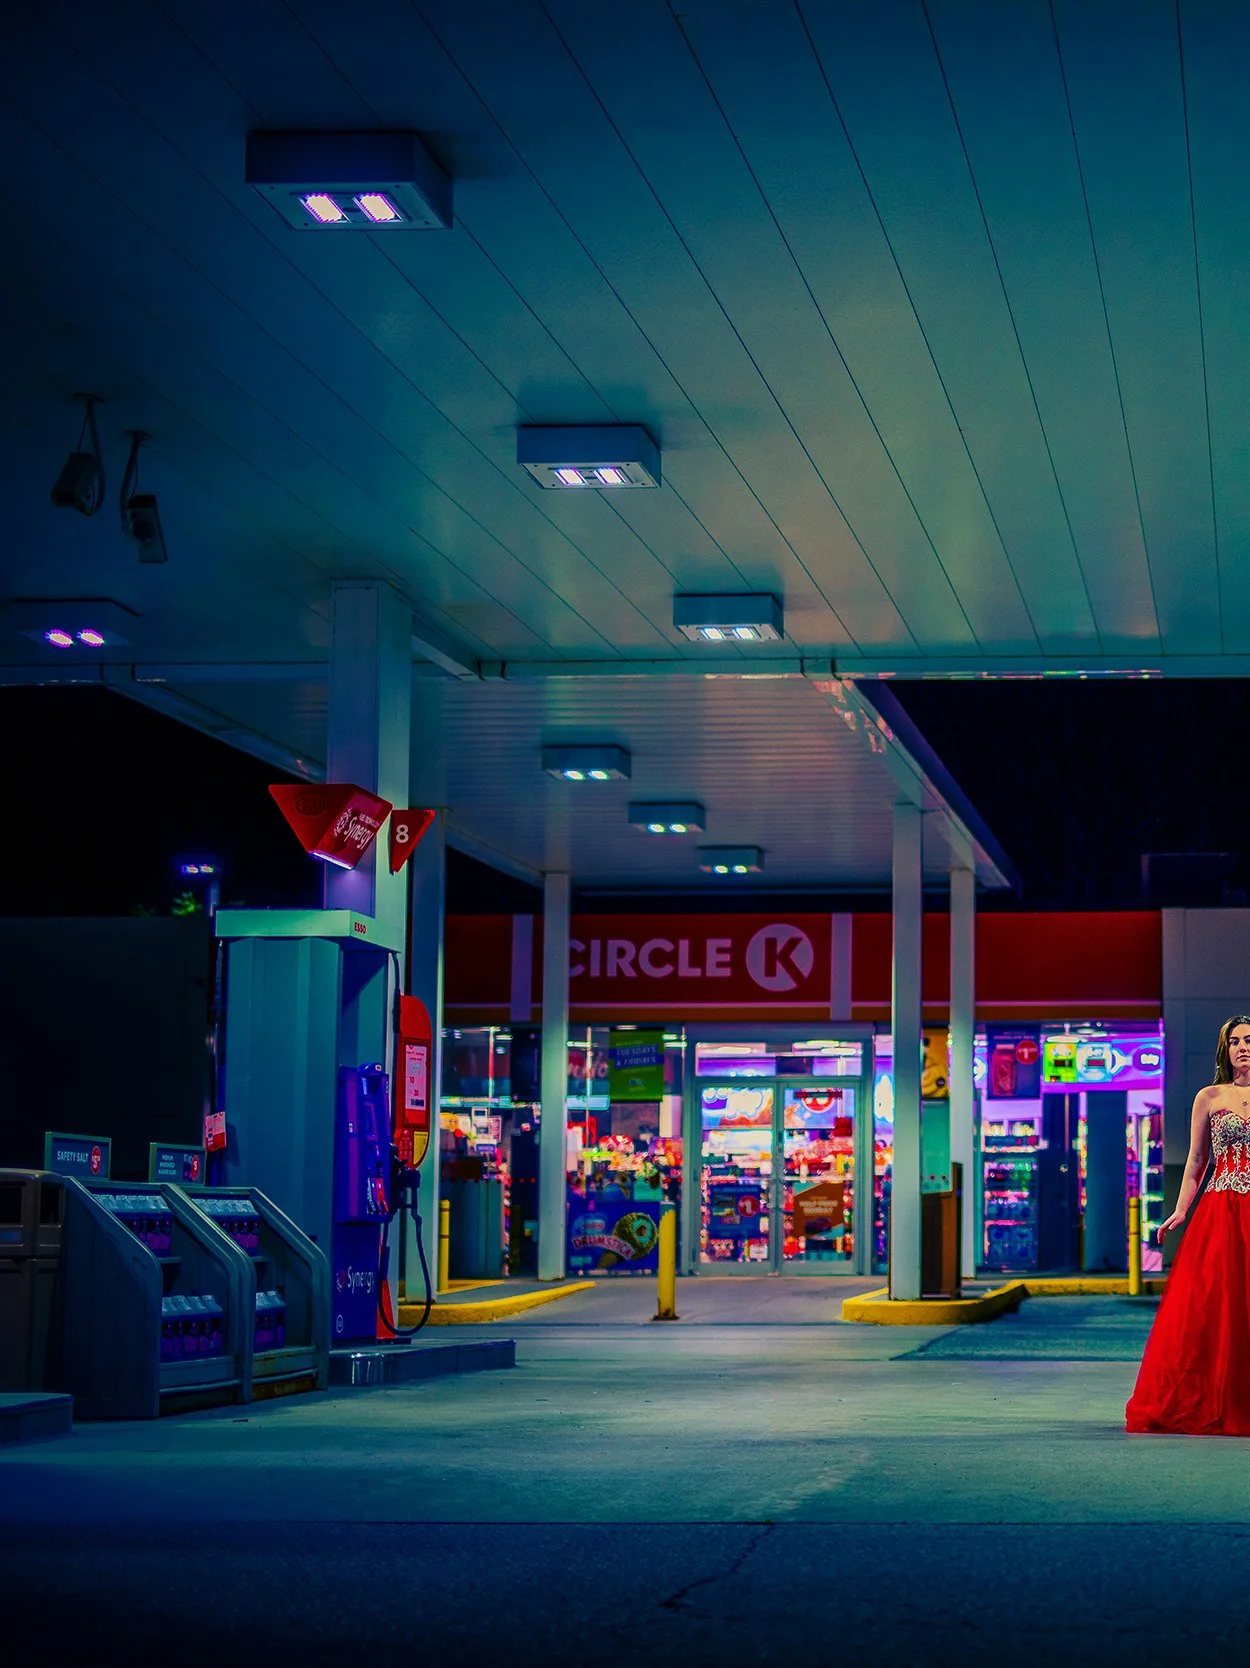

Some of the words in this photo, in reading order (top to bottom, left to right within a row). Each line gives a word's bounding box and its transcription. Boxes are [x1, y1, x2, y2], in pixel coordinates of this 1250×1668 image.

[343, 817, 375, 850] Synergy
[395, 824, 409, 844] 8
[354, 921, 367, 934] ESSO
[569, 938, 733, 979] CIRCLE
[763, 936, 810, 987] K
[56, 1150, 76, 1162] SAFETY
[77, 1152, 89, 1163] SALT
[573, 1236, 633, 1258] DRUMSTICK
[347, 1264, 375, 1294] Synergy
